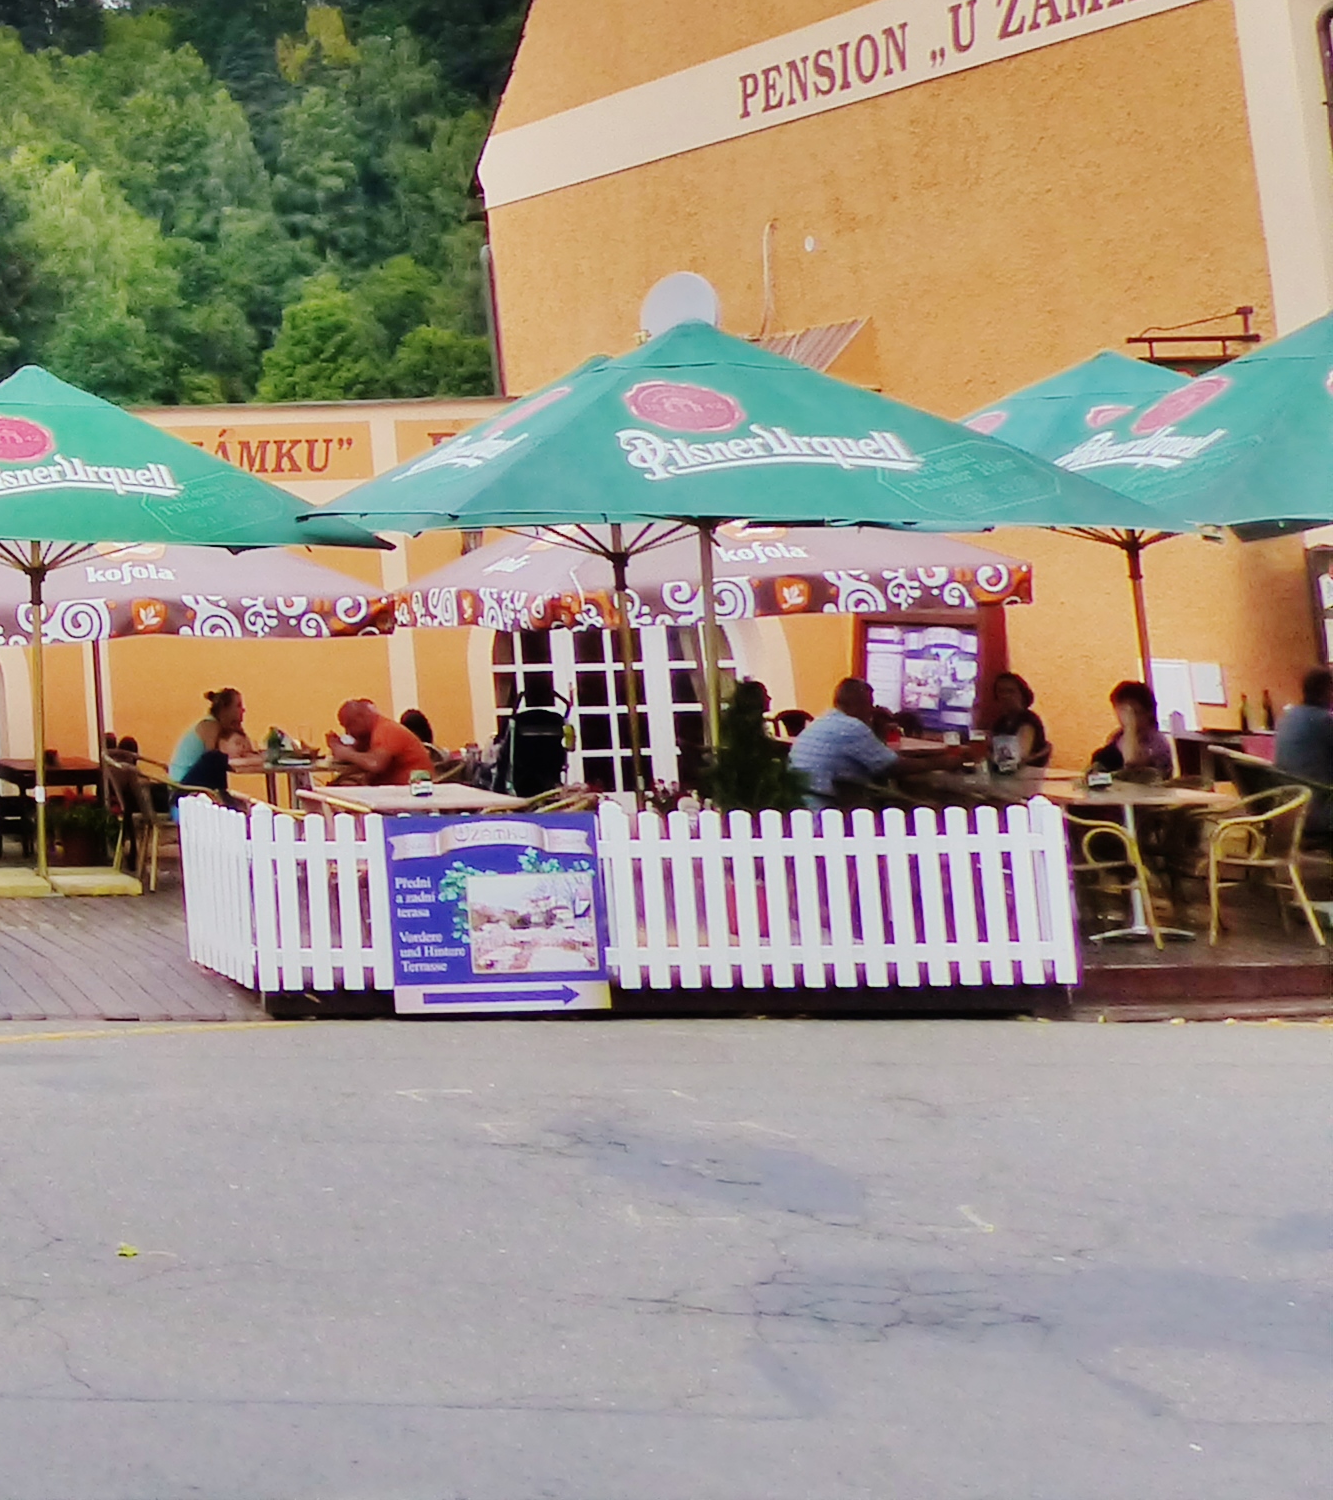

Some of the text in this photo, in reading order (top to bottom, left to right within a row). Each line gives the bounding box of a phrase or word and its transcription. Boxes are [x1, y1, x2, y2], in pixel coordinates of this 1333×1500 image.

[738, 21, 909, 119] PENSION
[615, 428, 764, 481] Pilsner
[749, 423, 917, 470] Urquell
[53, 453, 181, 495] Urquell
[716, 541, 808, 564] kofola
[85, 561, 176, 586] kofola
[399, 930, 444, 943] Vordere
[399, 946, 422, 958] und
[400, 960, 449, 973] Terrasse
